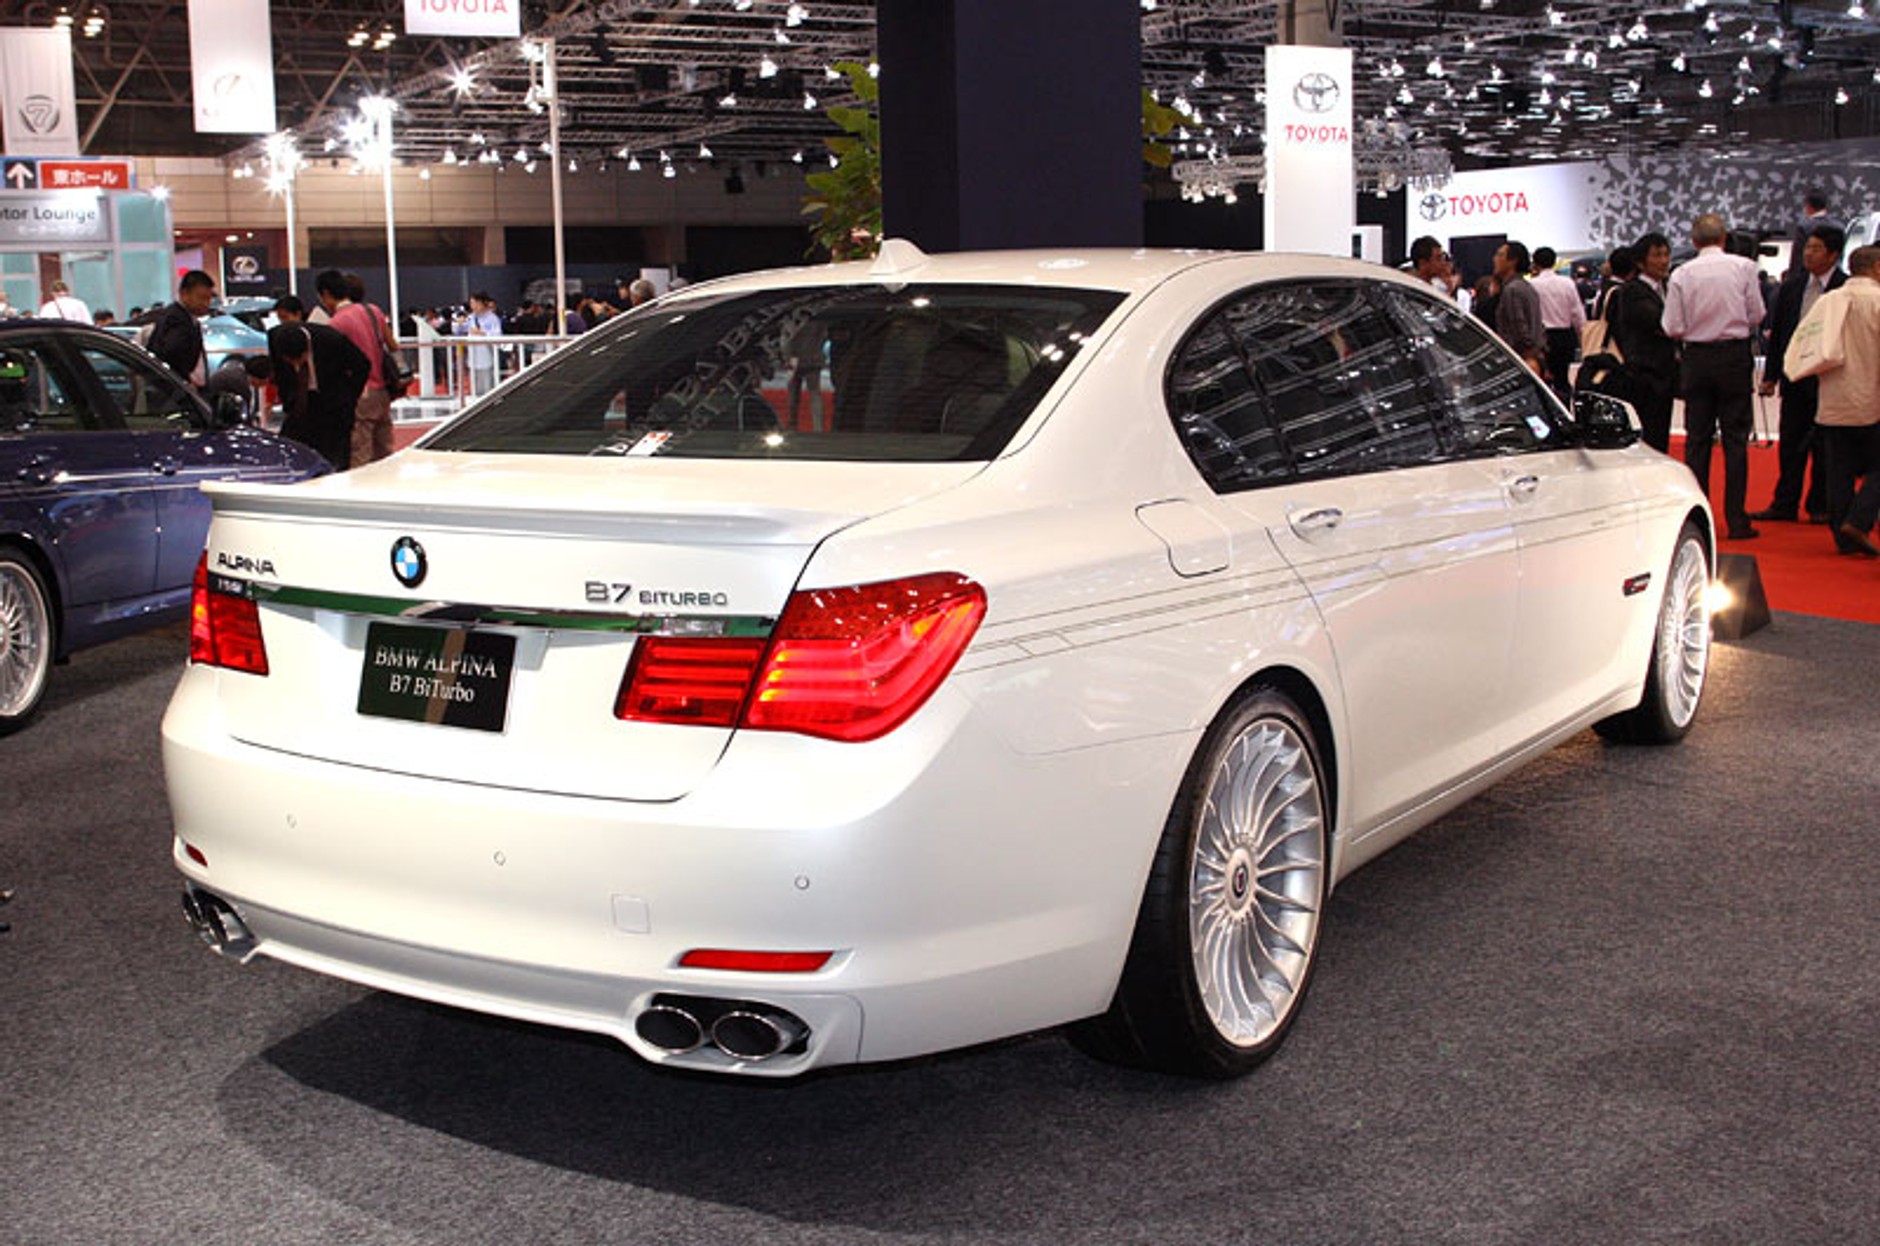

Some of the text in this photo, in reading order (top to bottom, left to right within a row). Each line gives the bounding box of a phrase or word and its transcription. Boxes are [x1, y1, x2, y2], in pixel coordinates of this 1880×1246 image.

[1284, 124, 1349, 142] TOYOTA
[0, 206, 96, 224] tor Lounge
[1448, 191, 1529, 216] TOYOTA
[217, 552, 278, 578] ALPINA
[585, 581, 728, 606] B7 BITURBO
[375, 645, 498, 679] BMW ALPINA
[390, 674, 475, 702] B7 BiTurbo
